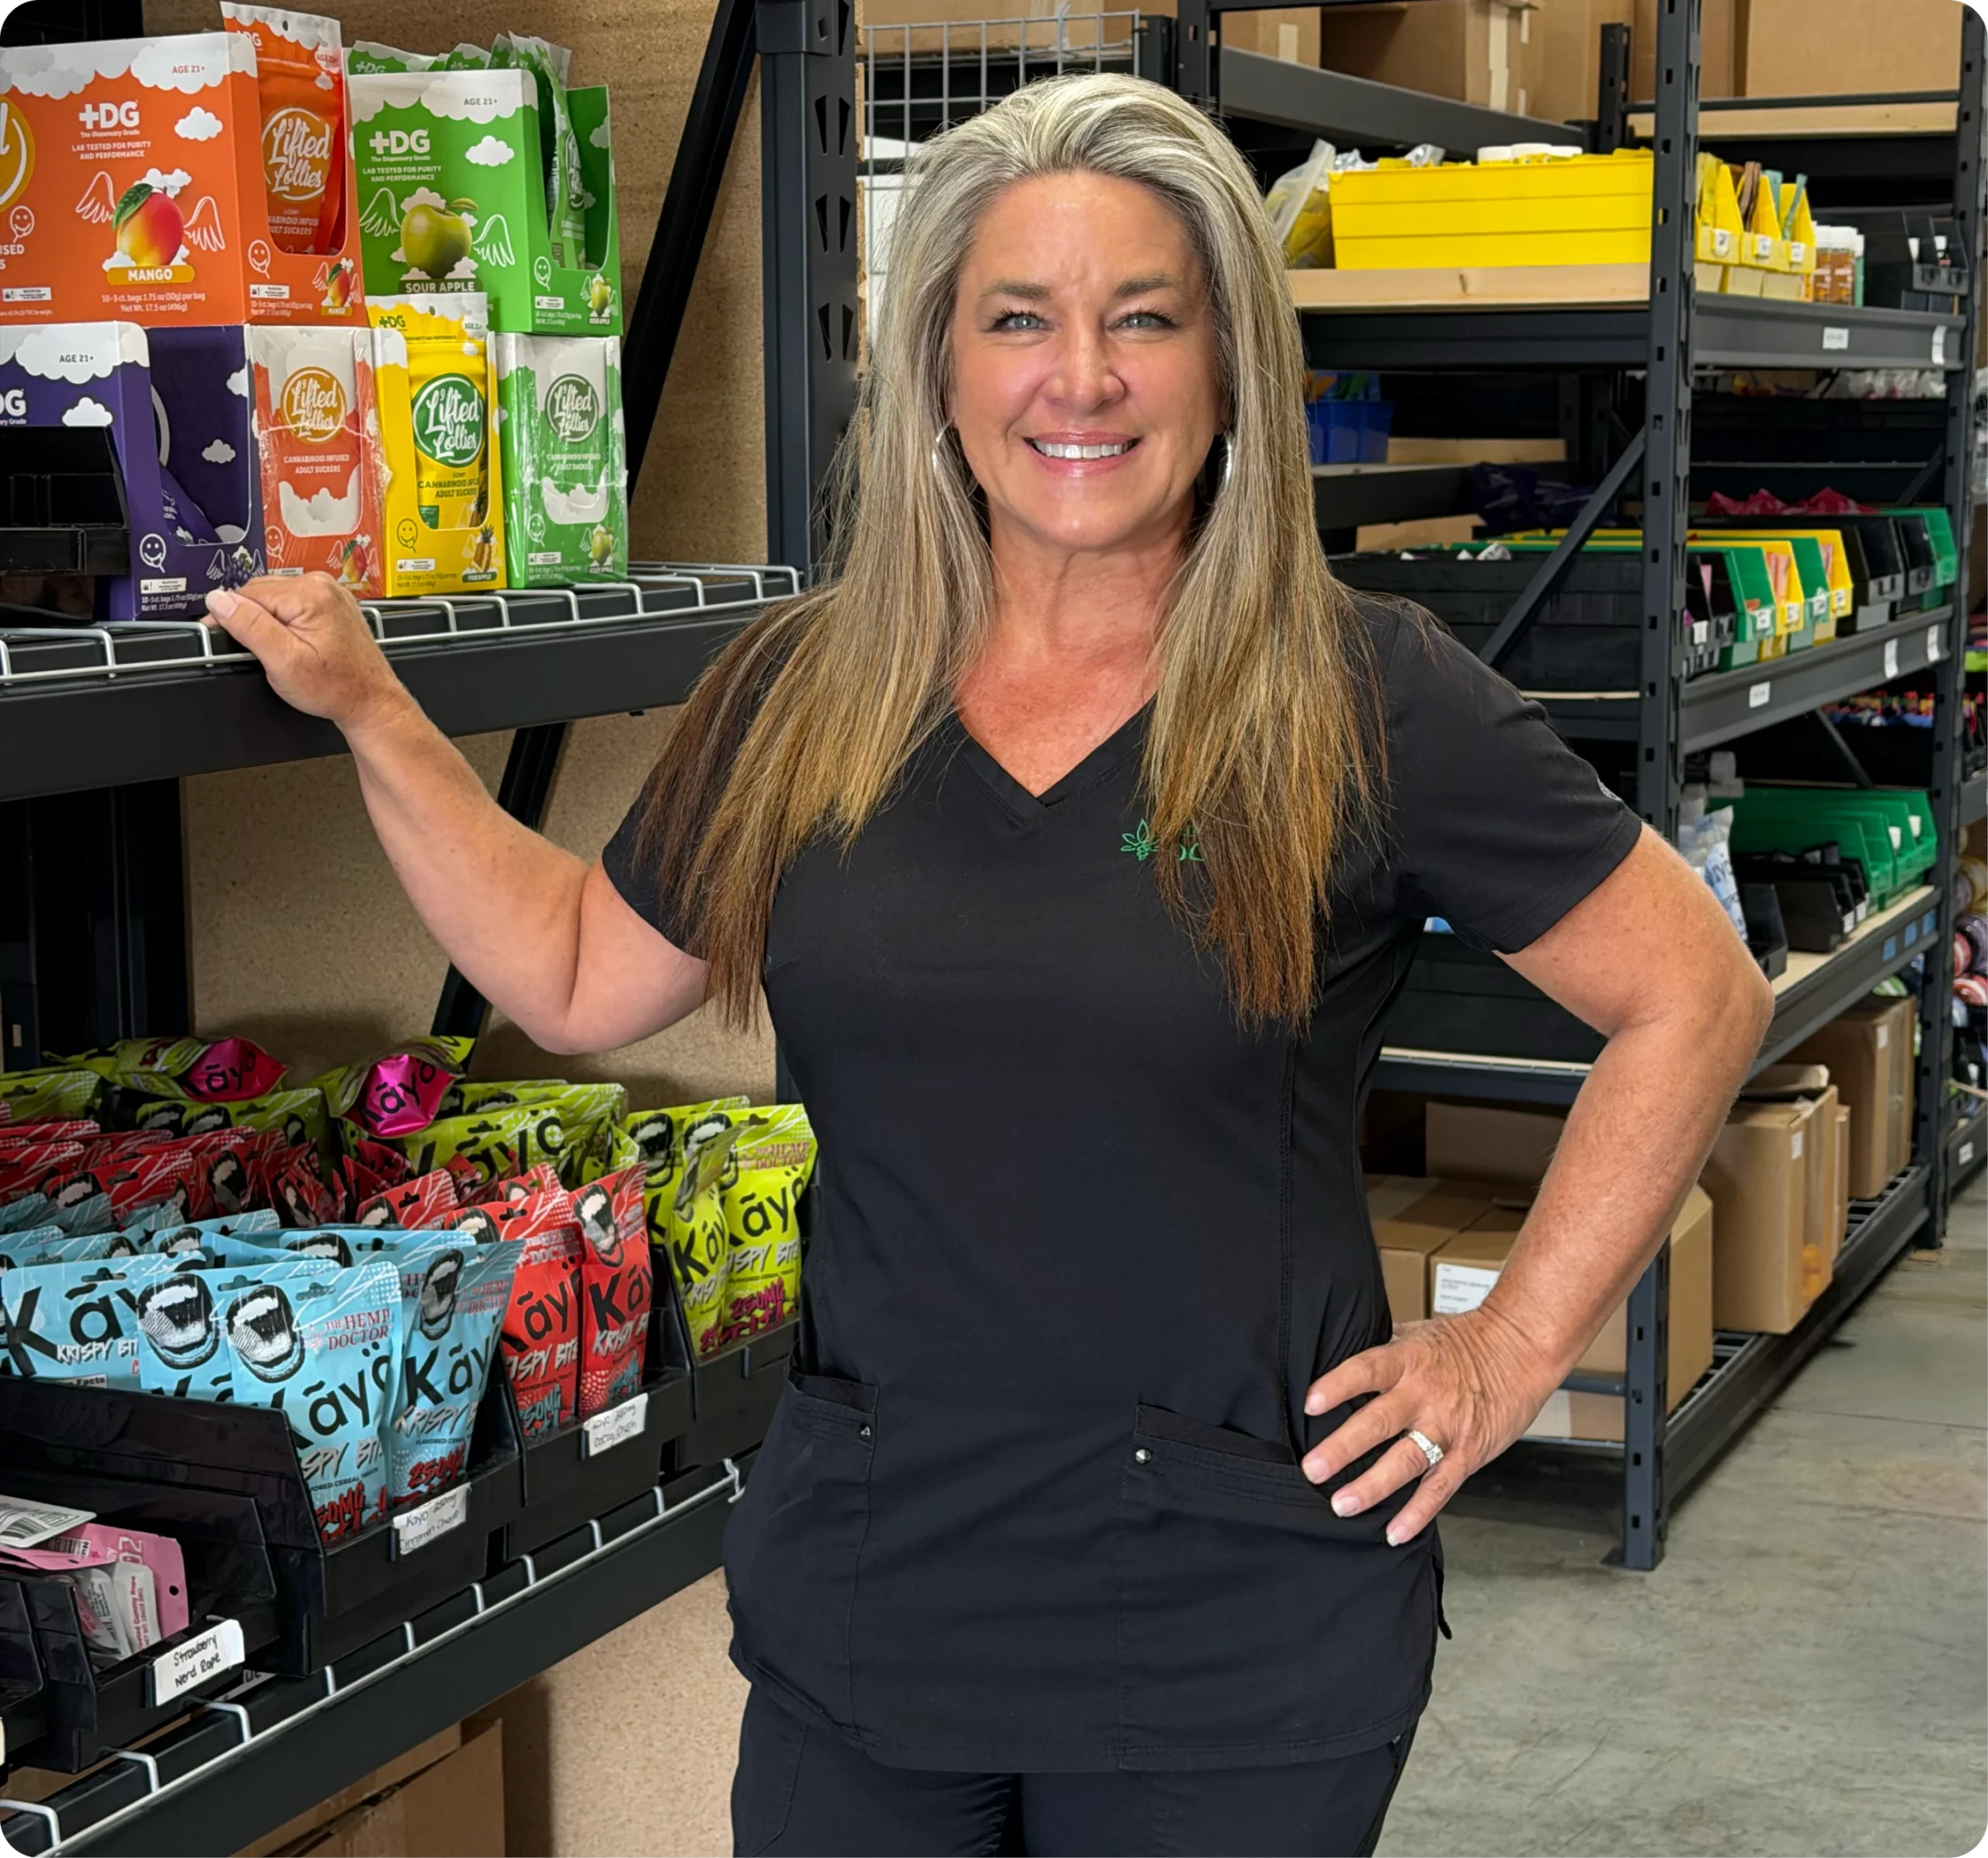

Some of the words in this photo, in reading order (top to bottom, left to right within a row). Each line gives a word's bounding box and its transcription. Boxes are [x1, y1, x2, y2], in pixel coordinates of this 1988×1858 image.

[269, 117, 330, 166] Lifted
[95, 150, 145, 159] PERFORMANCE
[272, 158, 322, 193] Lollies
[386, 173, 436, 182] PERFORMANCE
[127, 268, 173, 282] MANGO
[405, 282, 436, 293] SOUR
[439, 281, 475, 292] APPLE
[59, 355, 78, 363] AGE
[78, 354, 94, 363] 21+
[425, 387, 479, 435] Lifted
[554, 384, 592, 419] Lifted
[433, 425, 477, 460] Lollies
[418, 479, 467, 489] CANNABINOID
[435, 490, 455, 498] ADULT
[342, 1308, 391, 1331] HEMP
[328, 1325, 388, 1351] DOCTOR
[57, 1339, 113, 1367] KRISPY
[555, 1337, 578, 1370] BITE
[77, 1376, 106, 1387] Facts
[334, 1475, 360, 1487] CEREAL
[173, 1634, 218, 1667] Strawberry
[174, 1664, 198, 1689] Nerd
[200, 1652, 221, 1673] Rope
